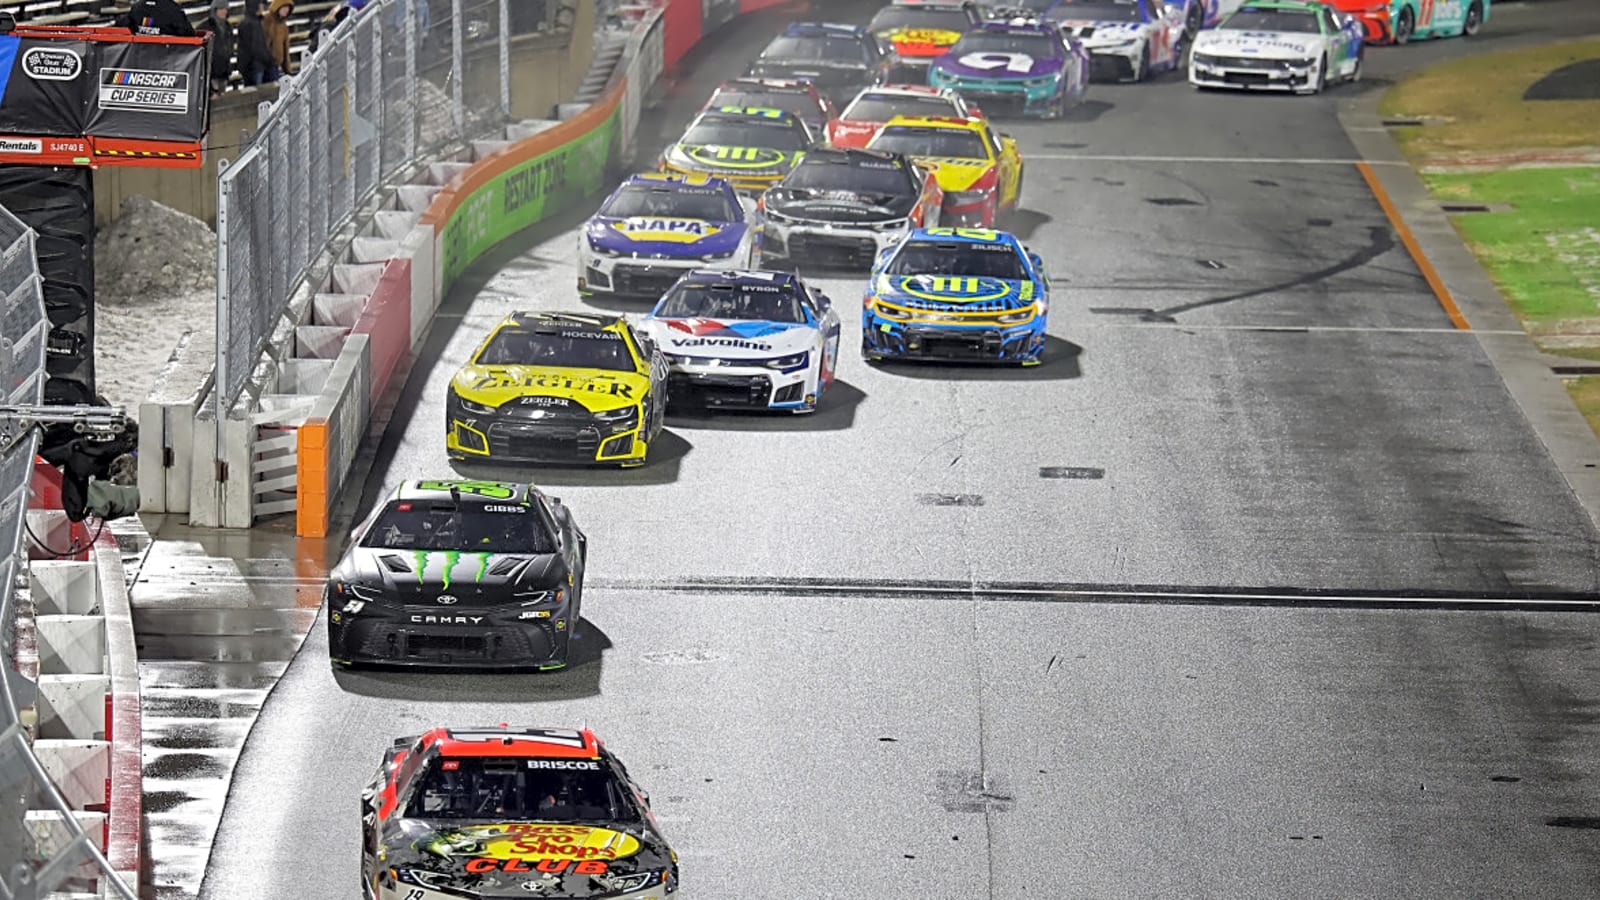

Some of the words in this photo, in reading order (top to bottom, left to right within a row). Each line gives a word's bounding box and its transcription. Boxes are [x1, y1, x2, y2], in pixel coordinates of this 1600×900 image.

[33, 66, 71, 76] STADIUM
[127, 72, 176, 88] NASCAR
[110, 89, 135, 101] CUP
[135, 91, 177, 104] SERIES
[0, 141, 37, 151] Rentals
[628, 218, 702, 236] NAPA
[741, 285, 779, 293] BYRON
[562, 330, 621, 341] HOCEVAR
[671, 338, 773, 352] Valvoline
[520, 397, 569, 407] ZEIGLER
[484, 504, 526, 514] GIBBS
[411, 615, 484, 625] CAMRY
[527, 760, 600, 771] BRISCOE
[505, 824, 590, 835] Bass
[511, 833, 574, 844] Pro
[510, 841, 616, 859] Shops
[465, 858, 609, 875] CLUB
